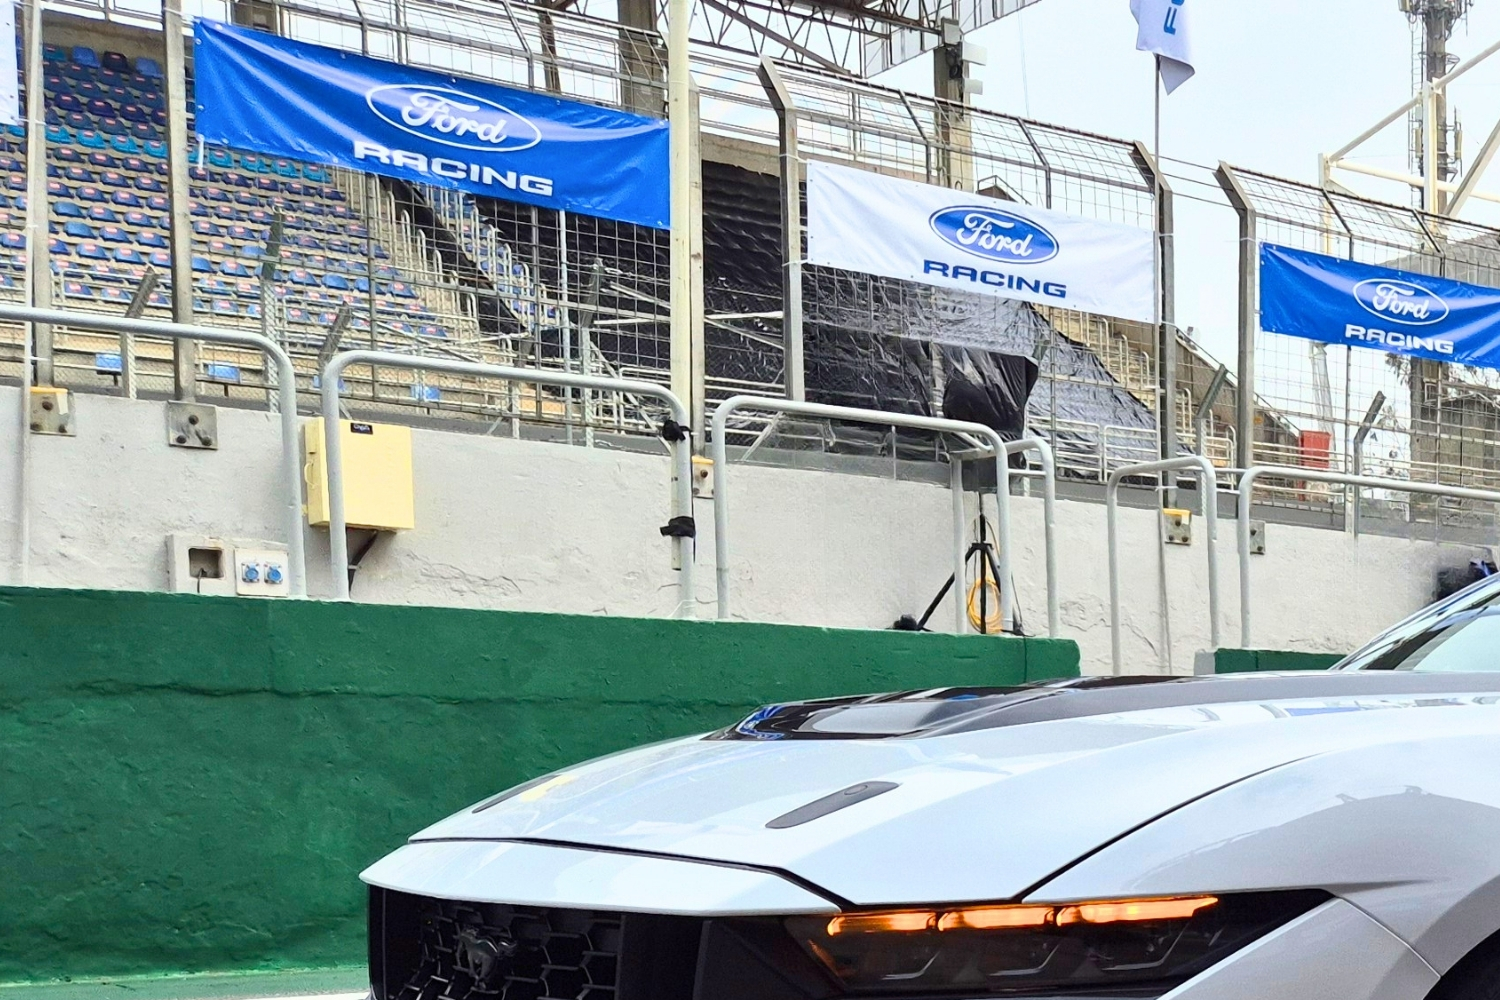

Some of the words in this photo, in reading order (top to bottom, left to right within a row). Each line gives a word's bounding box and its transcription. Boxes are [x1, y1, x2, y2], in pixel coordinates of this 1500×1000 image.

[402, 92, 508, 143] Ford
[353, 140, 553, 196] RACING
[956, 213, 1033, 256] Ford
[923, 259, 1066, 298] RACING
[1372, 283, 1430, 319] Ford
[1345, 324, 1454, 354] RACING
